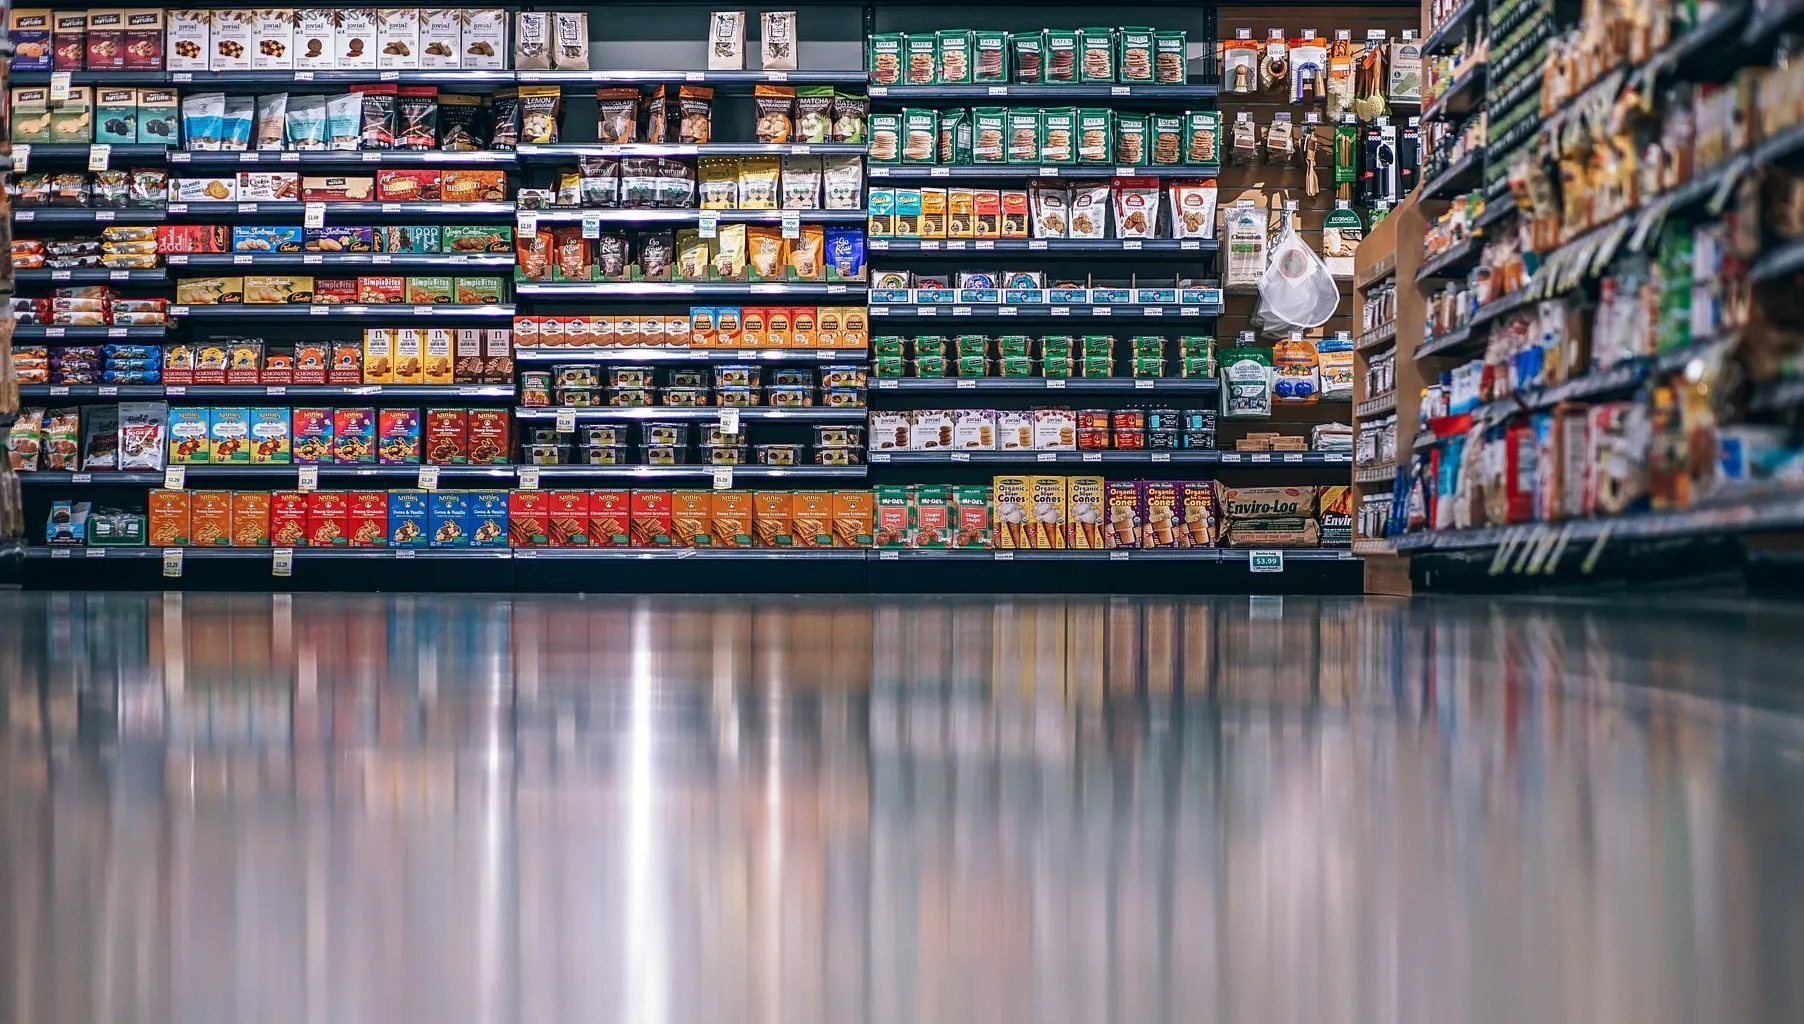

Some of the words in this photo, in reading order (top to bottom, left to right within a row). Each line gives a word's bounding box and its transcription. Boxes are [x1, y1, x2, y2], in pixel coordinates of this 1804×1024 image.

[178, 22, 197, 30] jovial
[221, 22, 240, 30] jovial
[263, 22, 281, 30] jovial
[305, 22, 323, 30] jovial
[346, 22, 365, 30] jovial
[389, 22, 407, 30] jovial
[431, 22, 450, 30] jovial
[473, 22, 492, 30] jovial
[527, 97, 552, 105] LEMON
[249, 177, 270, 187] Cookie
[383, 181, 418, 191] BISCOTTI
[446, 182, 481, 192] BISCOTTI
[249, 226, 276, 236] Shortbread
[444, 227, 461, 237] Ginger
[167, 226, 175, 251] Chocolate
[838, 236, 849, 245] Go
[529, 243, 545, 254] Raw
[563, 243, 580, 255] Raw
[601, 243, 620, 253] Raw
[645, 245, 663, 256] Raw
[760, 242, 777, 251] Raw
[835, 243, 852, 254] Raw
[264, 278, 292, 286] Shortbread
[317, 280, 355, 289] SimpleBites
[363, 278, 401, 286] SimpleBites
[411, 278, 449, 286] SimpleBites
[459, 278, 497, 286] SimpleBites
[375, 330, 382, 338] n
[405, 330, 412, 338] n
[435, 330, 442, 338] n
[465, 330, 472, 338] n
[494, 330, 502, 338] n
[881, 417, 897, 425] jovial
[924, 416, 941, 424] jovial
[966, 416, 982, 424] jovial
[1005, 417, 1021, 425] jovial
[1046, 417, 1063, 425] jovial
[1110, 488, 1136, 496] Organic
[1148, 488, 1175, 496] Organic
[1184, 488, 1210, 496] Organic
[281, 493, 302, 501] Annie's
[318, 493, 340, 501] Annie's
[358, 493, 379, 501] Annie's
[397, 493, 418, 501] Annie's
[438, 493, 460, 501] Annie's
[478, 493, 500, 501] Annie's
[518, 493, 540, 501] Annie's
[558, 493, 580, 501] Annie's
[598, 493, 619, 501] Annie's
[641, 493, 662, 501] Annie's
[802, 494, 823, 502] Annie's
[842, 494, 864, 502] Annie's
[997, 494, 1026, 503] Cones
[1033, 494, 1061, 503] Cones
[1072, 494, 1100, 503] Cones
[1109, 498, 1137, 506] Cones
[1148, 498, 1175, 506] Cones
[1183, 498, 1211, 506] Cones
[1227, 499, 1299, 514] Enviro-Log
[1324, 514, 1352, 525] Envir
[1256, 557, 1277, 565] $3.99
